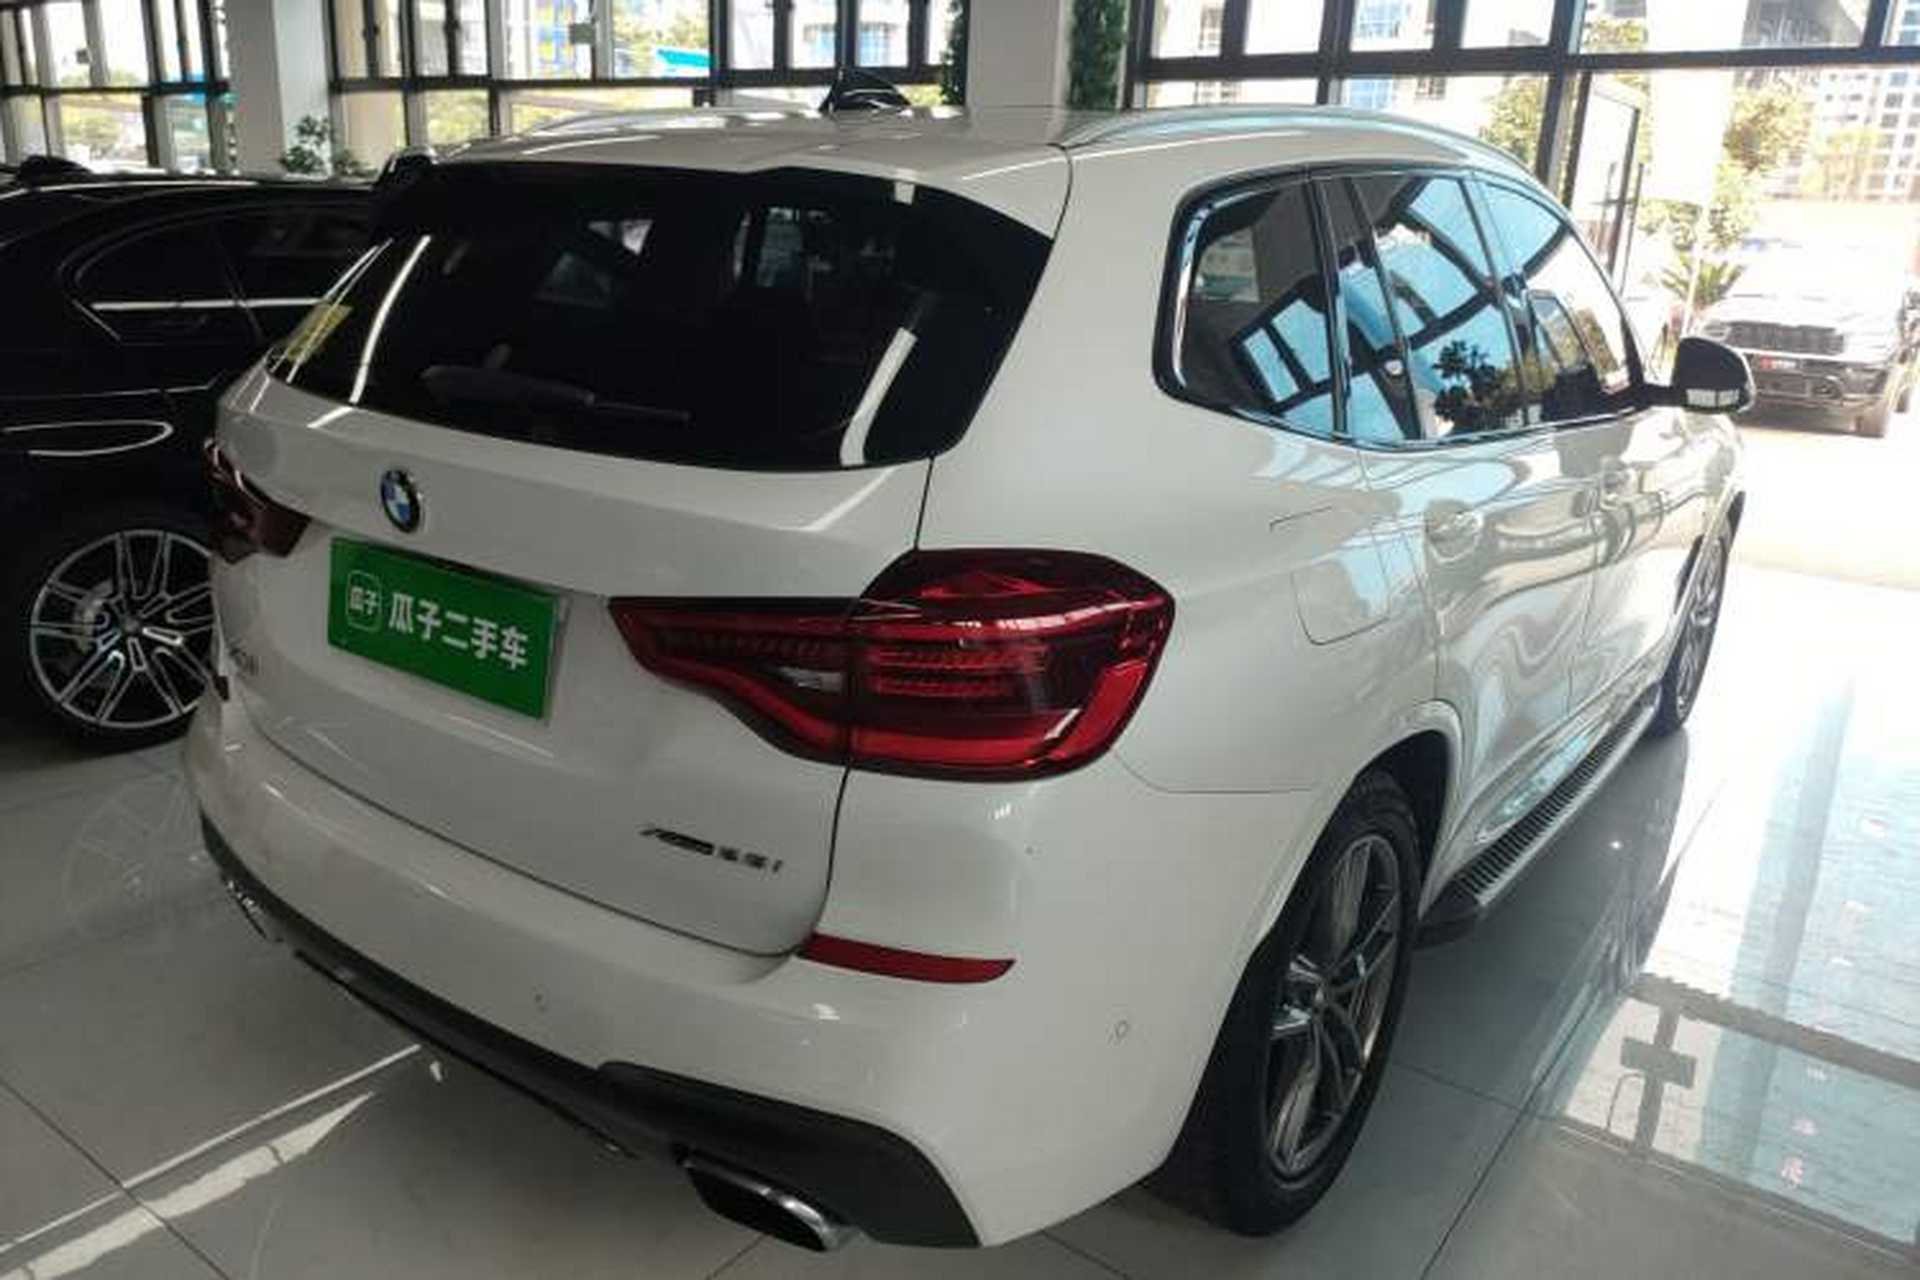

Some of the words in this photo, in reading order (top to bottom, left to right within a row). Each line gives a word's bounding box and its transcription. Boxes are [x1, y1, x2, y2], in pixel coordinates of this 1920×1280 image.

[389, 592, 528, 670] 瓜子二手车
